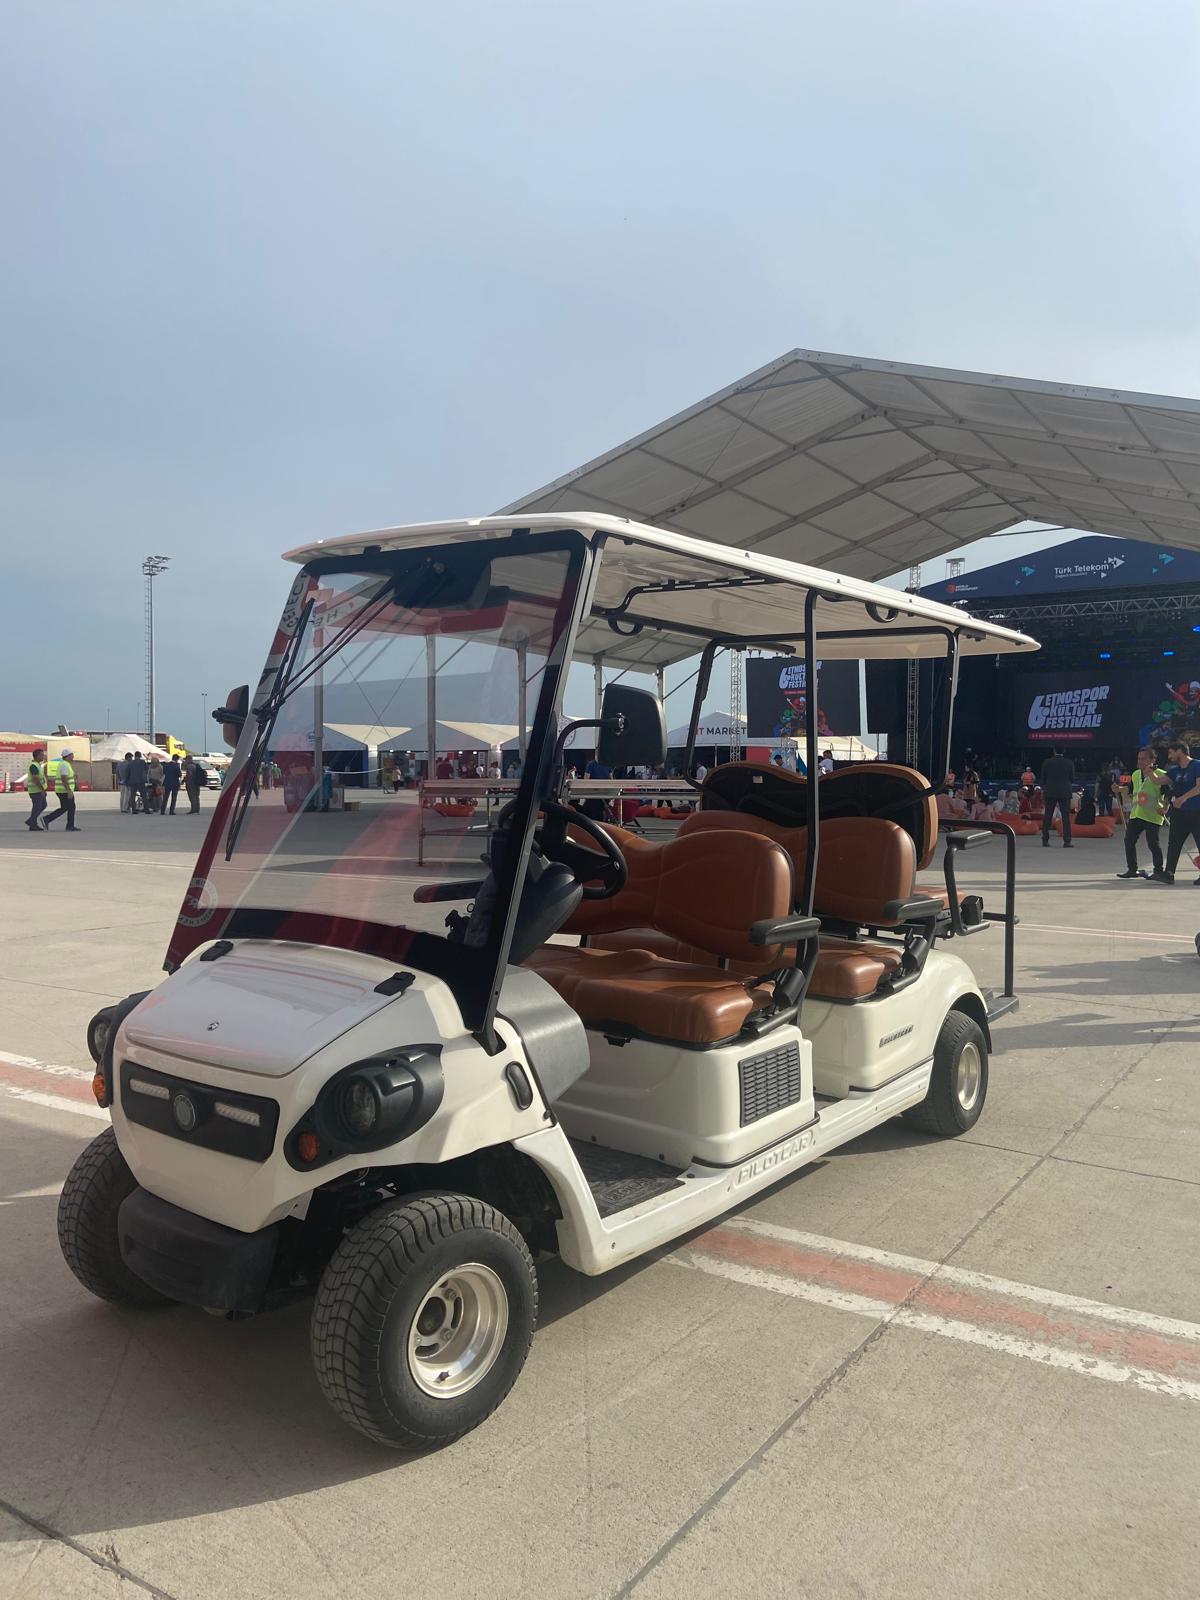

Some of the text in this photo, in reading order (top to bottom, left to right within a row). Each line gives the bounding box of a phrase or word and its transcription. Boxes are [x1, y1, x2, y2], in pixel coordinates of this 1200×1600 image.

[1054, 563, 1109, 574] Türk Telekom
[1045, 685, 1110, 706] ETNOSPOR
[737, 1134, 809, 1183] PILOTCAR
